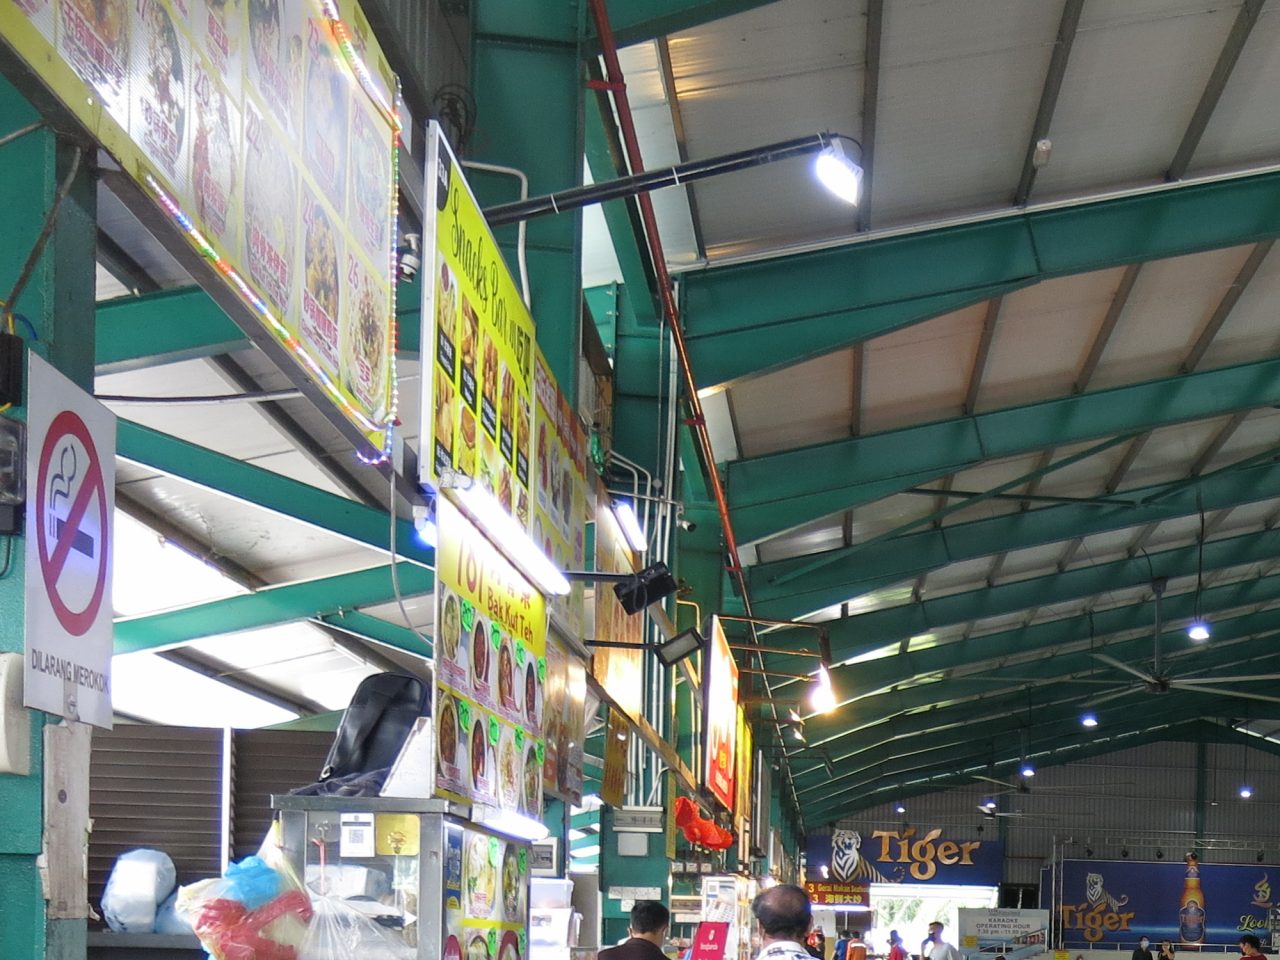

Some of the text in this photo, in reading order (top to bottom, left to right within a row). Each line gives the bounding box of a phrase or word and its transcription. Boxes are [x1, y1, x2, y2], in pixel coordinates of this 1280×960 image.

[451, 184, 507, 345] Snacks Bar
[488, 588, 504, 620] Bak
[504, 602, 519, 632] Kut
[520, 612, 534, 645] Teh
[32, 649, 109, 694] DILARANG MEROKOK
[871, 828, 981, 881] Tiger
[808, 883, 815, 893] 3
[812, 894, 819, 904] 3
[1057, 902, 1135, 942] Tiger
